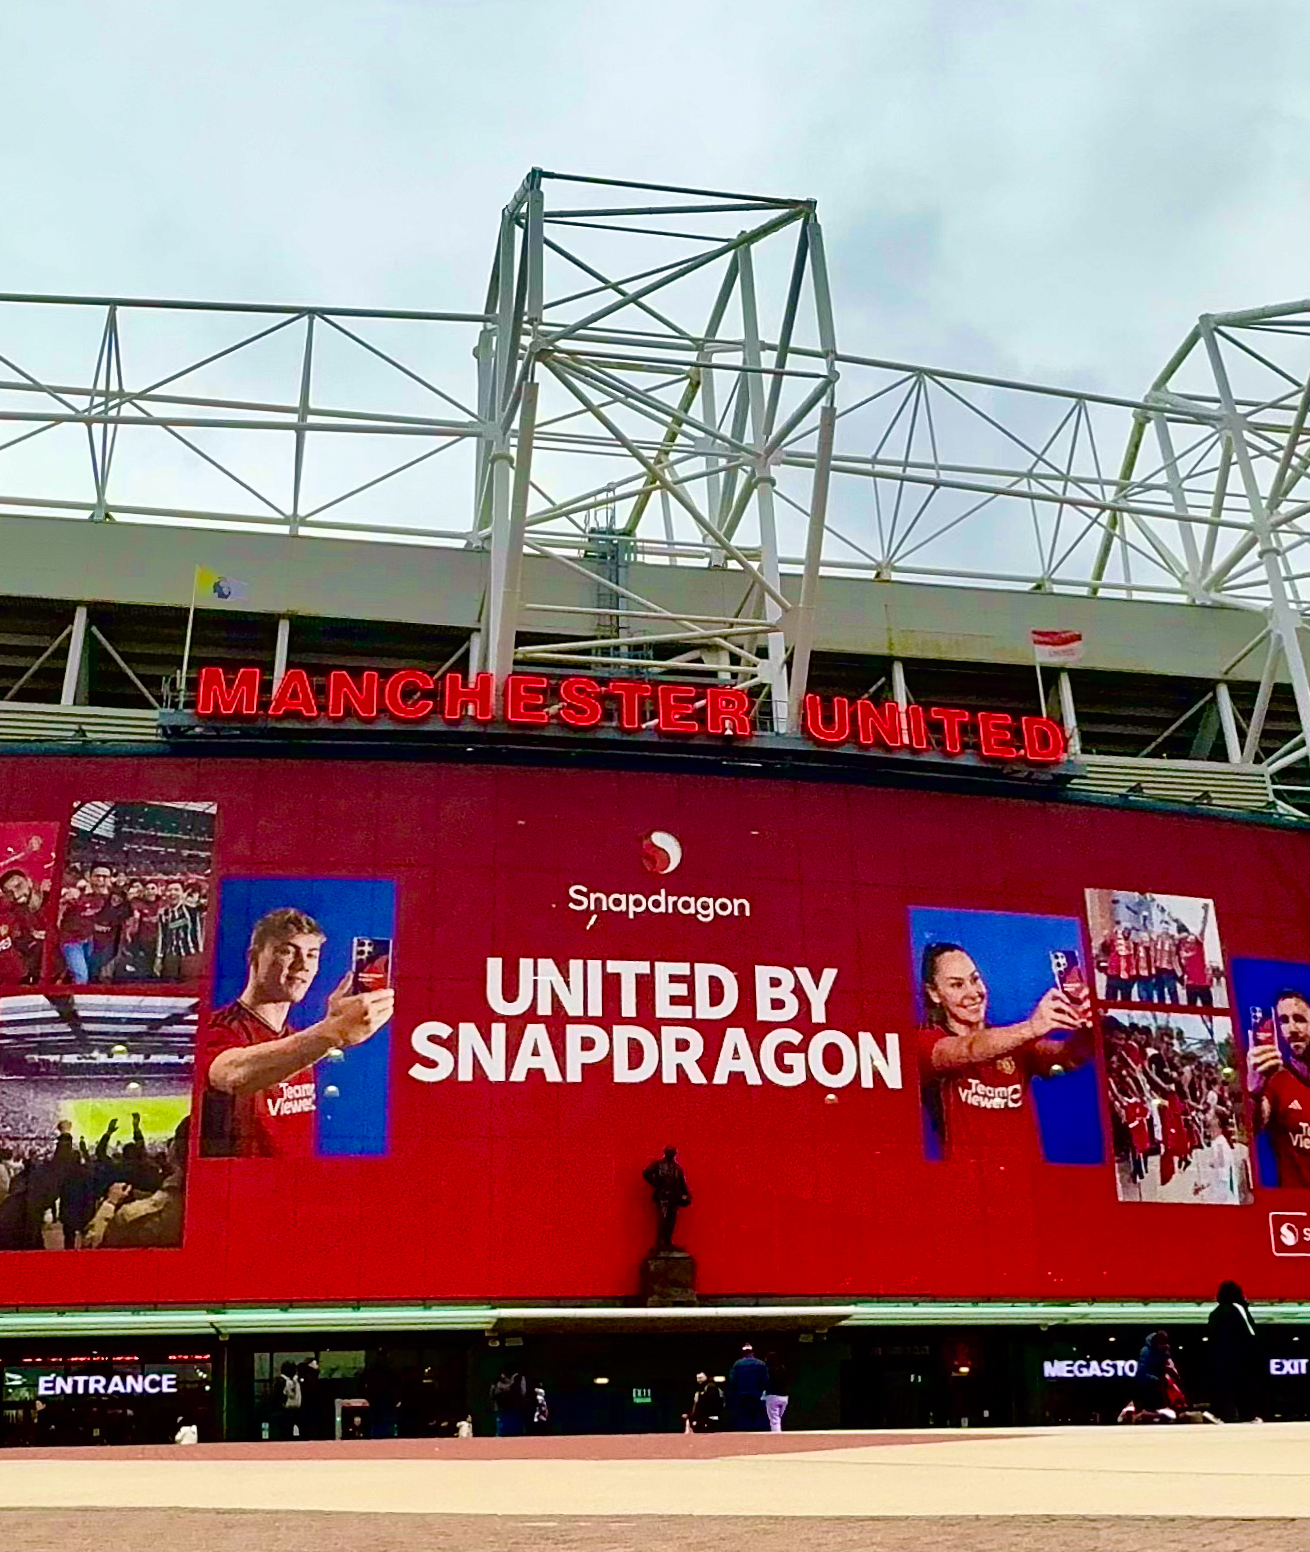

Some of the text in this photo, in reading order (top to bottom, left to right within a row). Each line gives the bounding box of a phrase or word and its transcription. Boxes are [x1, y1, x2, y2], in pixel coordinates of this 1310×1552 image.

[195, 666, 1067, 764] MANCHESTER UNITED
[568, 885, 750, 923] Snapdragon
[486, 957, 838, 1024] UNITED BY
[408, 1021, 903, 1089] SNAPDRAGON
[957, 1086, 1007, 1109] Viewer
[967, 1078, 1007, 1098] Team
[1044, 1355, 1138, 1378] MEGASTO
[1269, 1358, 1309, 1375] EXIT
[38, 1374, 178, 1395] ENTRANCE
